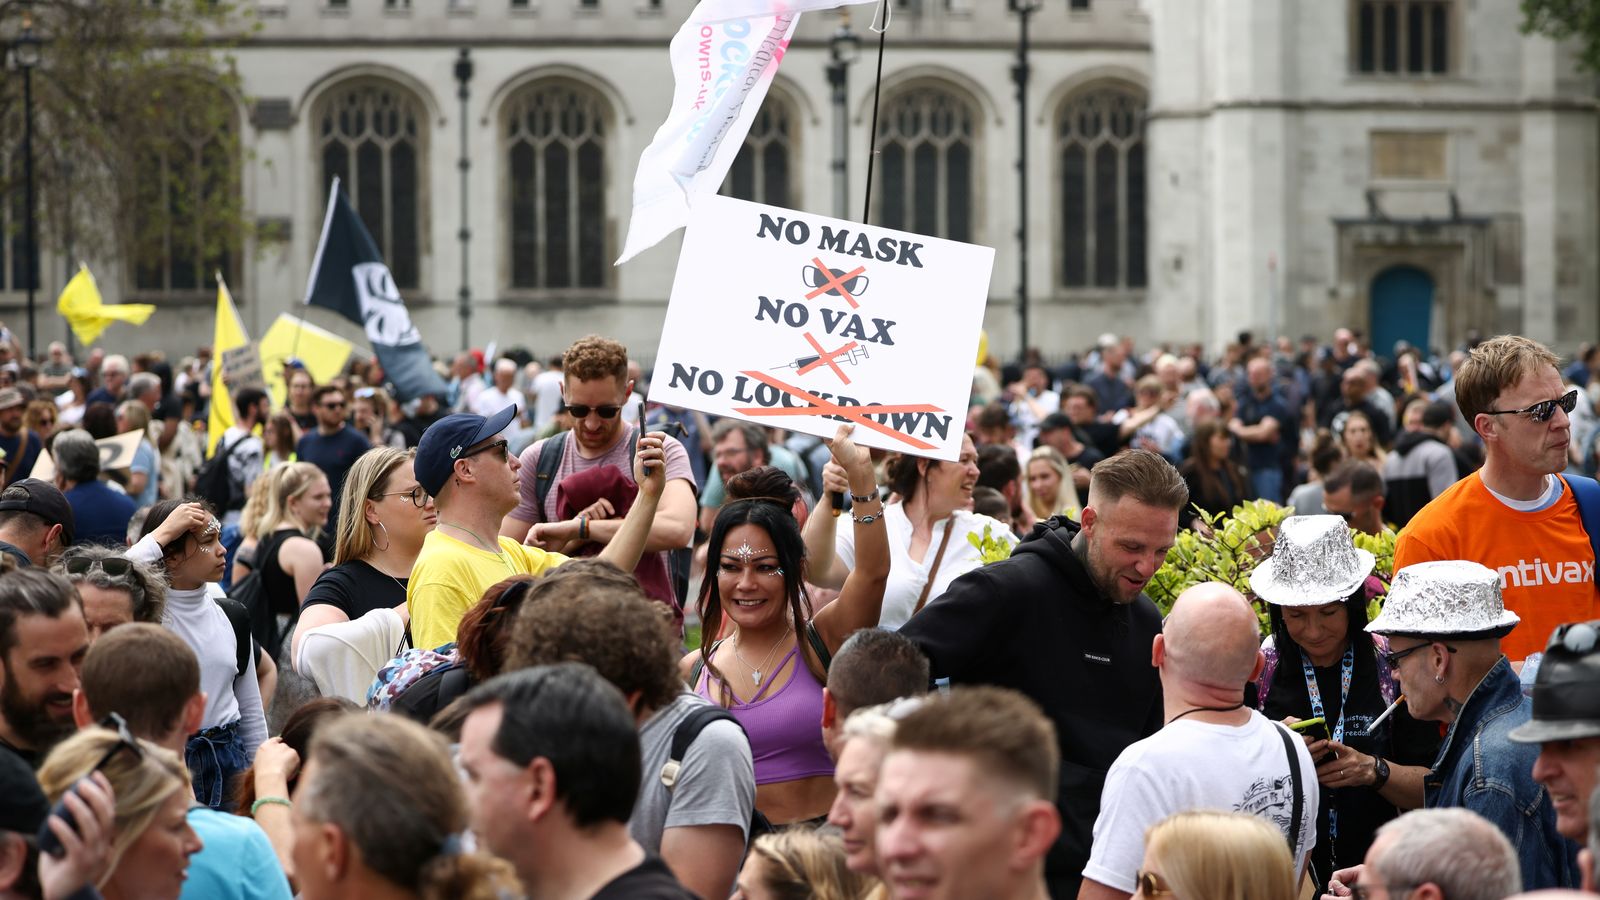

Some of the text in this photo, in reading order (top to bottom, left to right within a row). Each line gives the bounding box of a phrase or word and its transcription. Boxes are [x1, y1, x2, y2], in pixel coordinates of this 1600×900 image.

[691, 25, 713, 111] owns.uk
[756, 213, 924, 268] NO MASK
[755, 295, 897, 346] NO VAX
[668, 362, 724, 396] NO
[1497, 558, 1595, 589] ntivax
